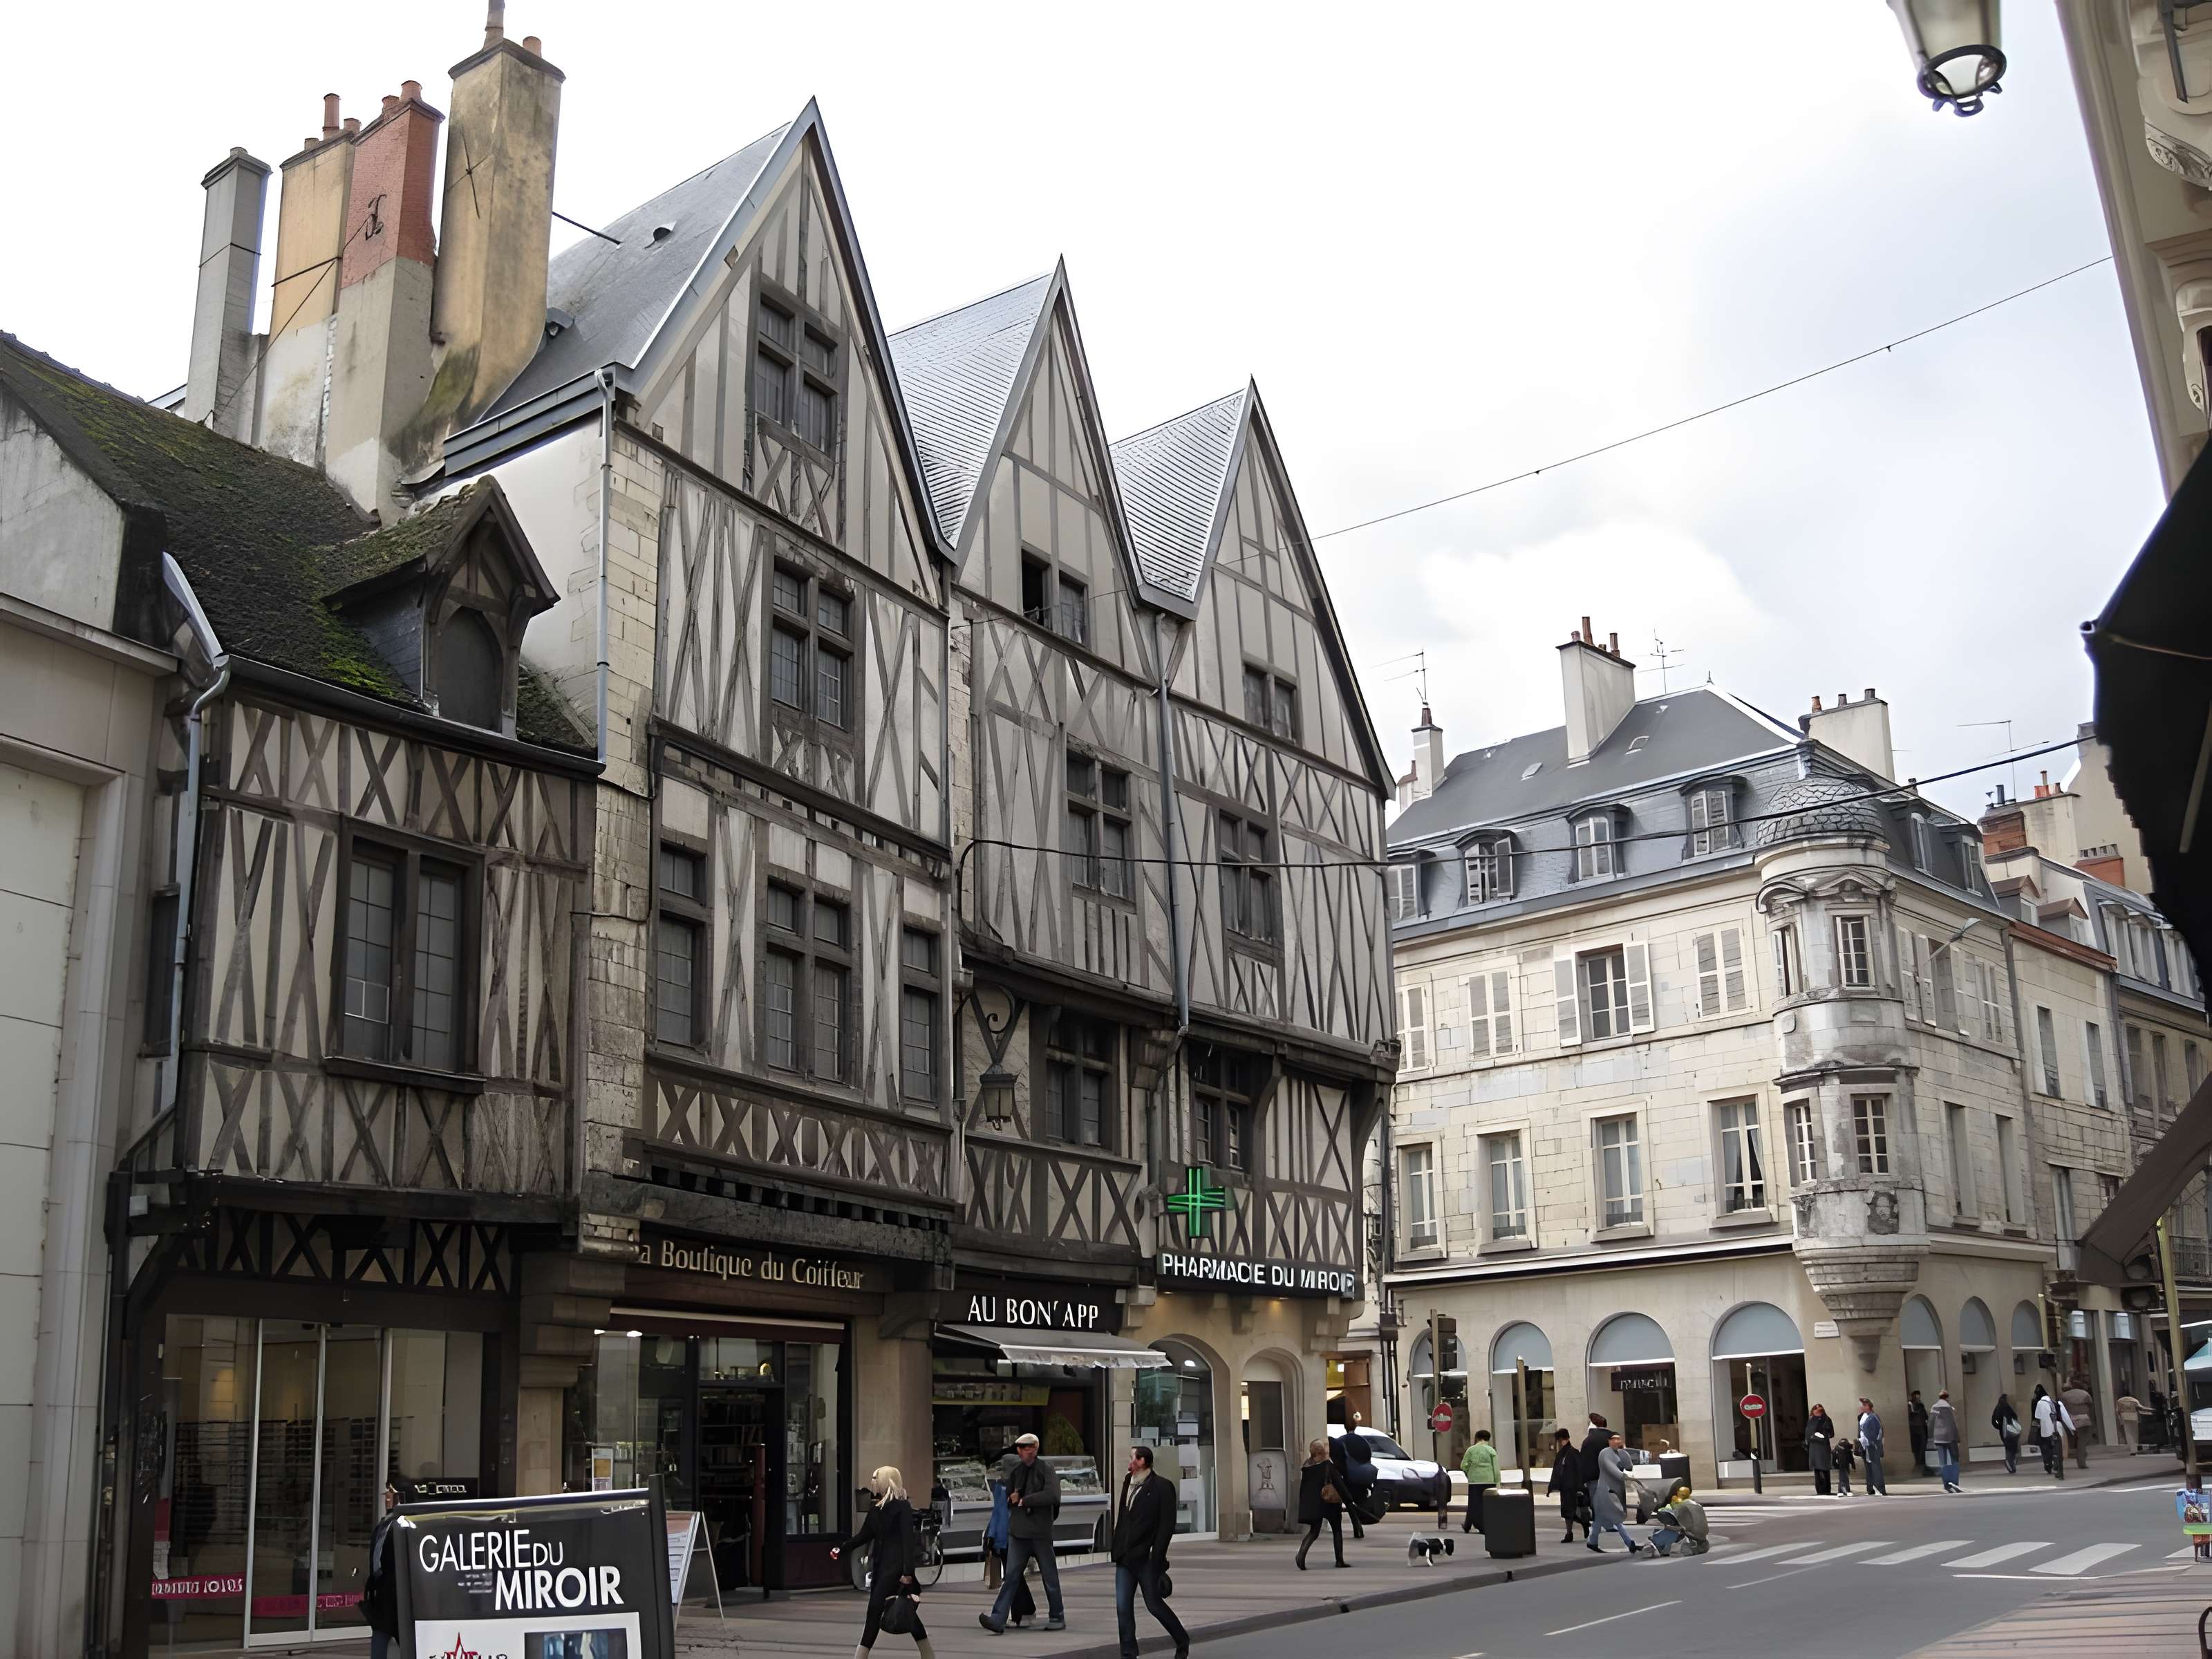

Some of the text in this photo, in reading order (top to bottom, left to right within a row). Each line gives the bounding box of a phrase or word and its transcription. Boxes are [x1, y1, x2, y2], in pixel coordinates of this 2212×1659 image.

[661, 1239, 753, 1280] Boutique
[760, 1251, 784, 1281] du
[1162, 1253, 1266, 1284] PHARMACIE
[1271, 1266, 1294, 1287] DU
[968, 1295, 995, 1322] AU
[419, 1529, 563, 1572] GALERIE DU
[494, 1566, 625, 1611] MIROIR
